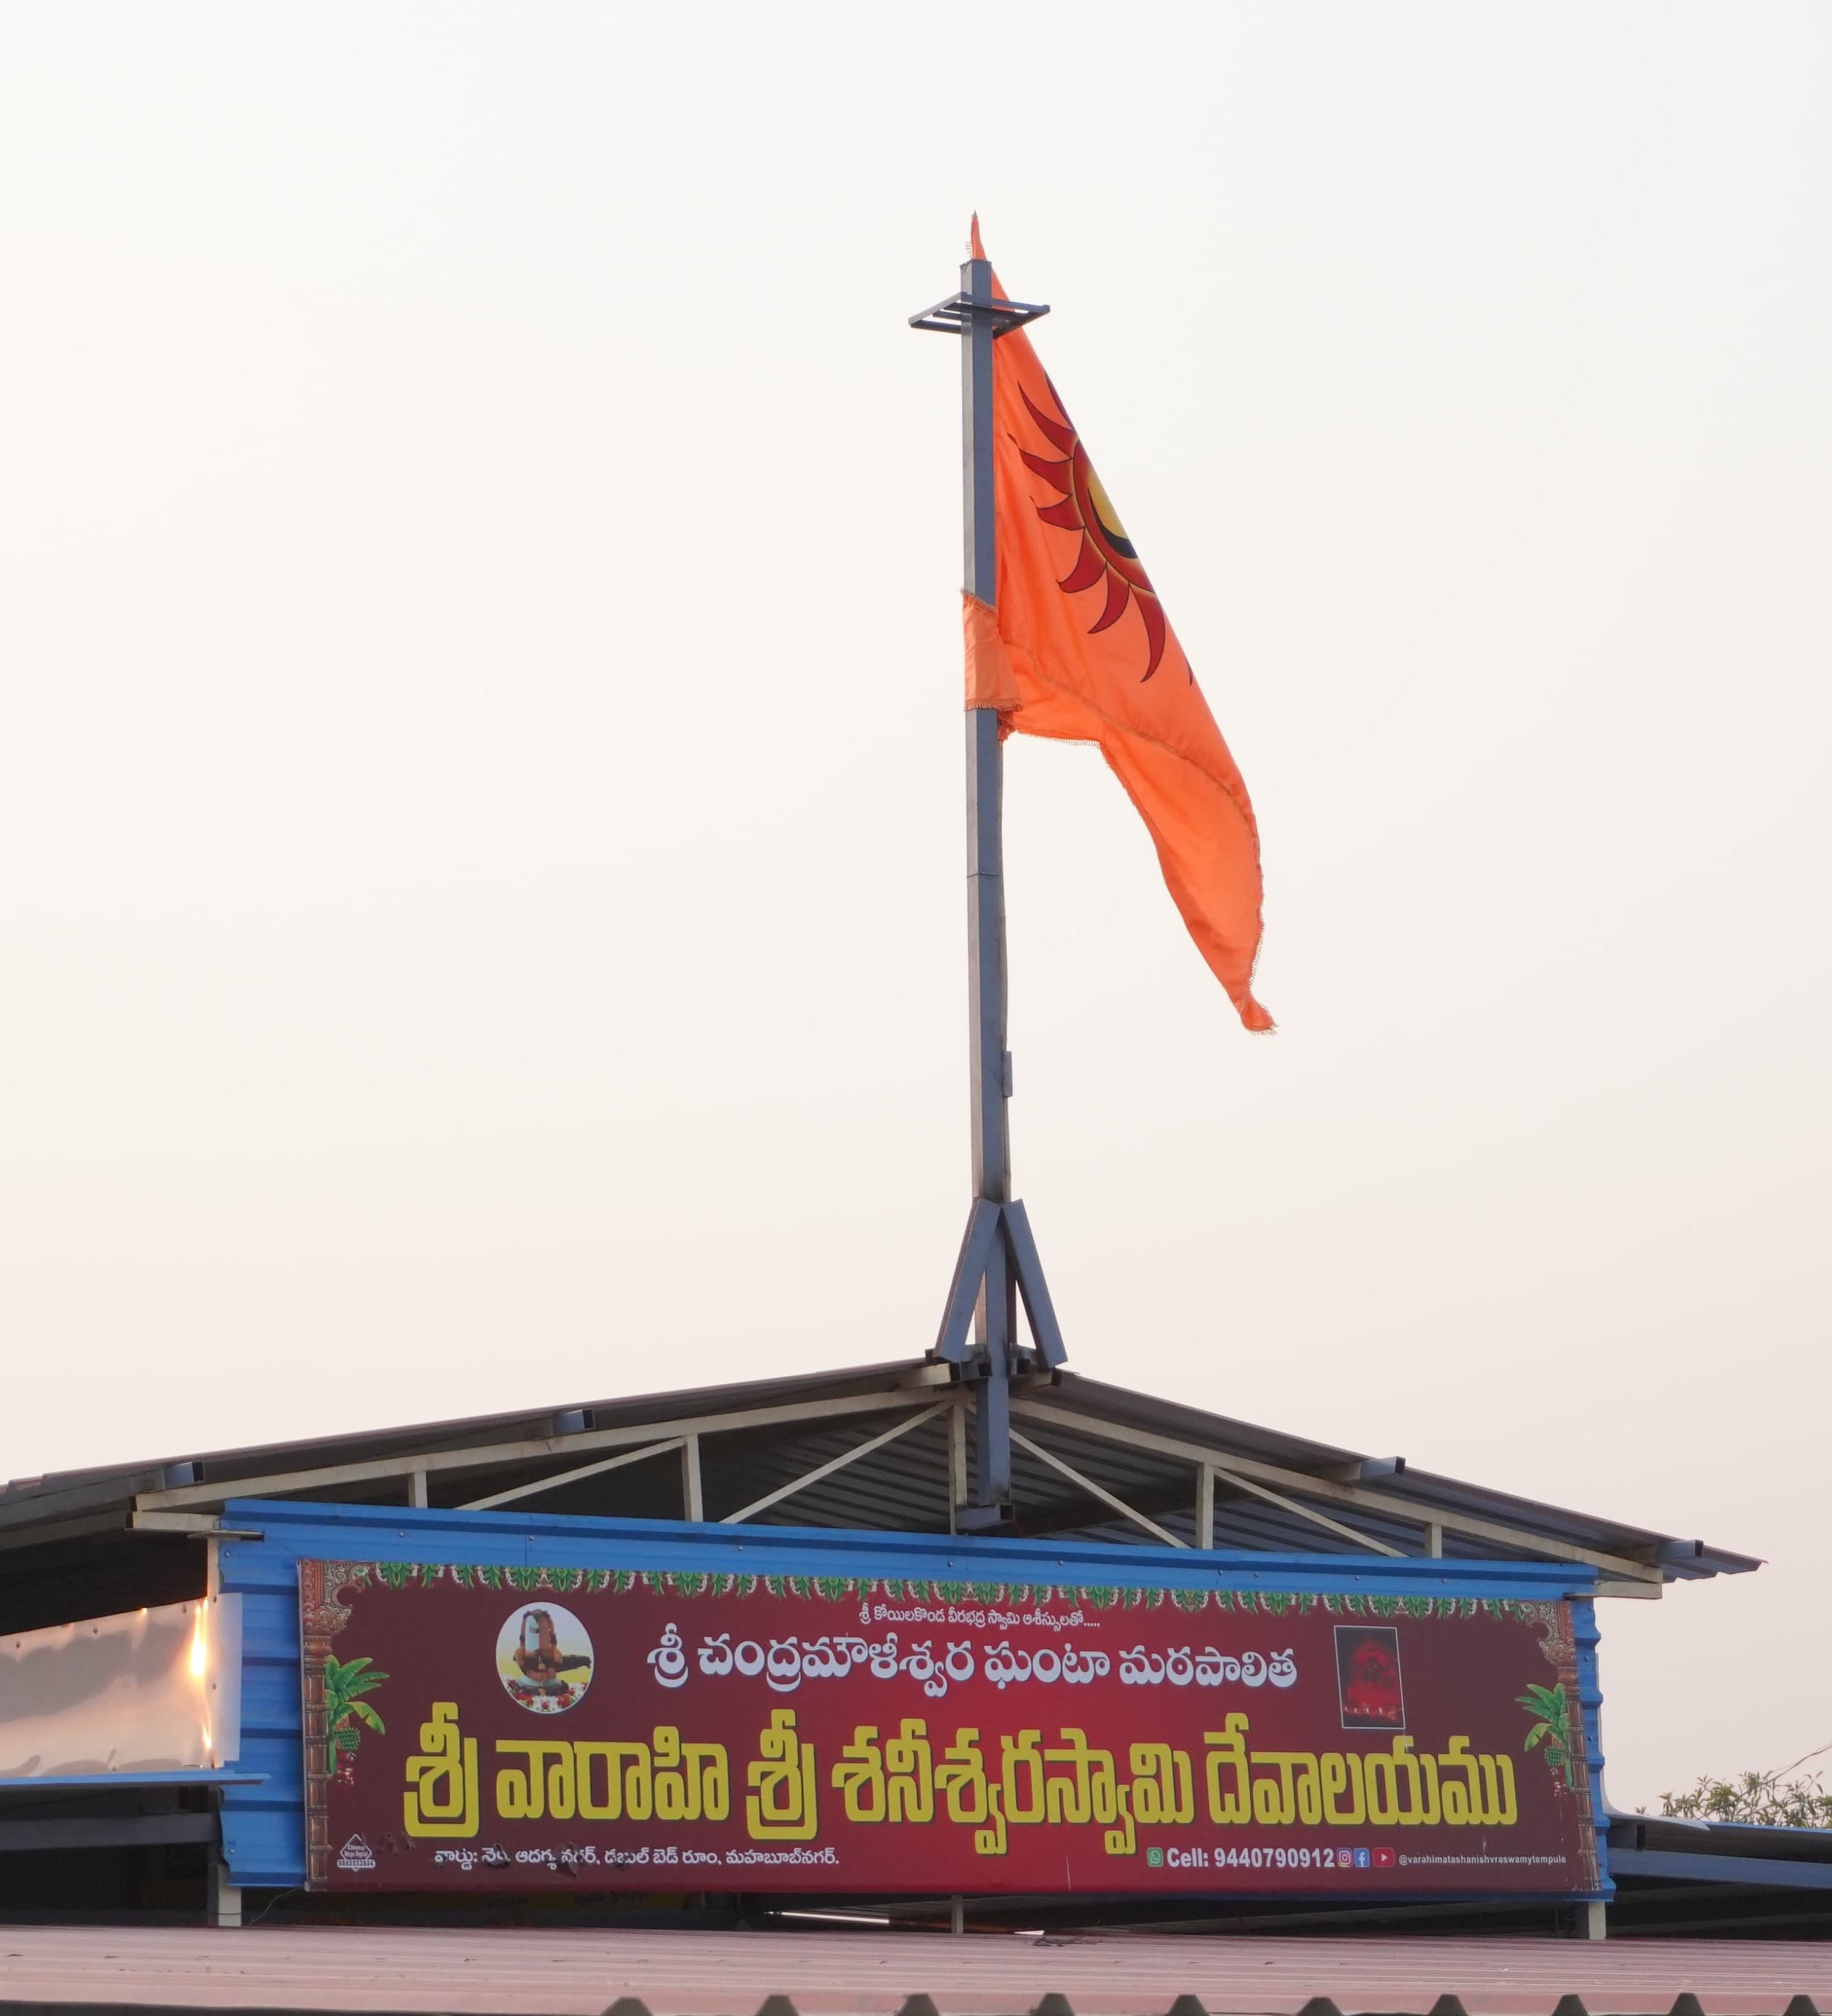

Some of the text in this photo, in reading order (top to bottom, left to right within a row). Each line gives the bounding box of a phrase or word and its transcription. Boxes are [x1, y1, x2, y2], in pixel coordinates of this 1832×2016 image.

[859, 1602, 871, 1624] శ్రీ
[874, 1604, 945, 1622] కోయిలకొండ
[948, 1607, 986, 1628] వీరభద్ర
[988, 1610, 1020, 1630] స్వామి
[646, 1623, 1297, 1697] శ్రీ చంద్రమౌళీశ్వర ఘంటా మఠపాలిత
[403, 1702, 1518, 1855] శ్రీ వారాహి శ్రీ శనీశ్వరస్వామి దేవాలయము
[653, 1846, 678, 1864] బెడ్
[1167, 1848, 1335, 1867] Cell: 9440790912
[1398, 1854, 1566, 1866] @varahimatashanishvraswamytempule
